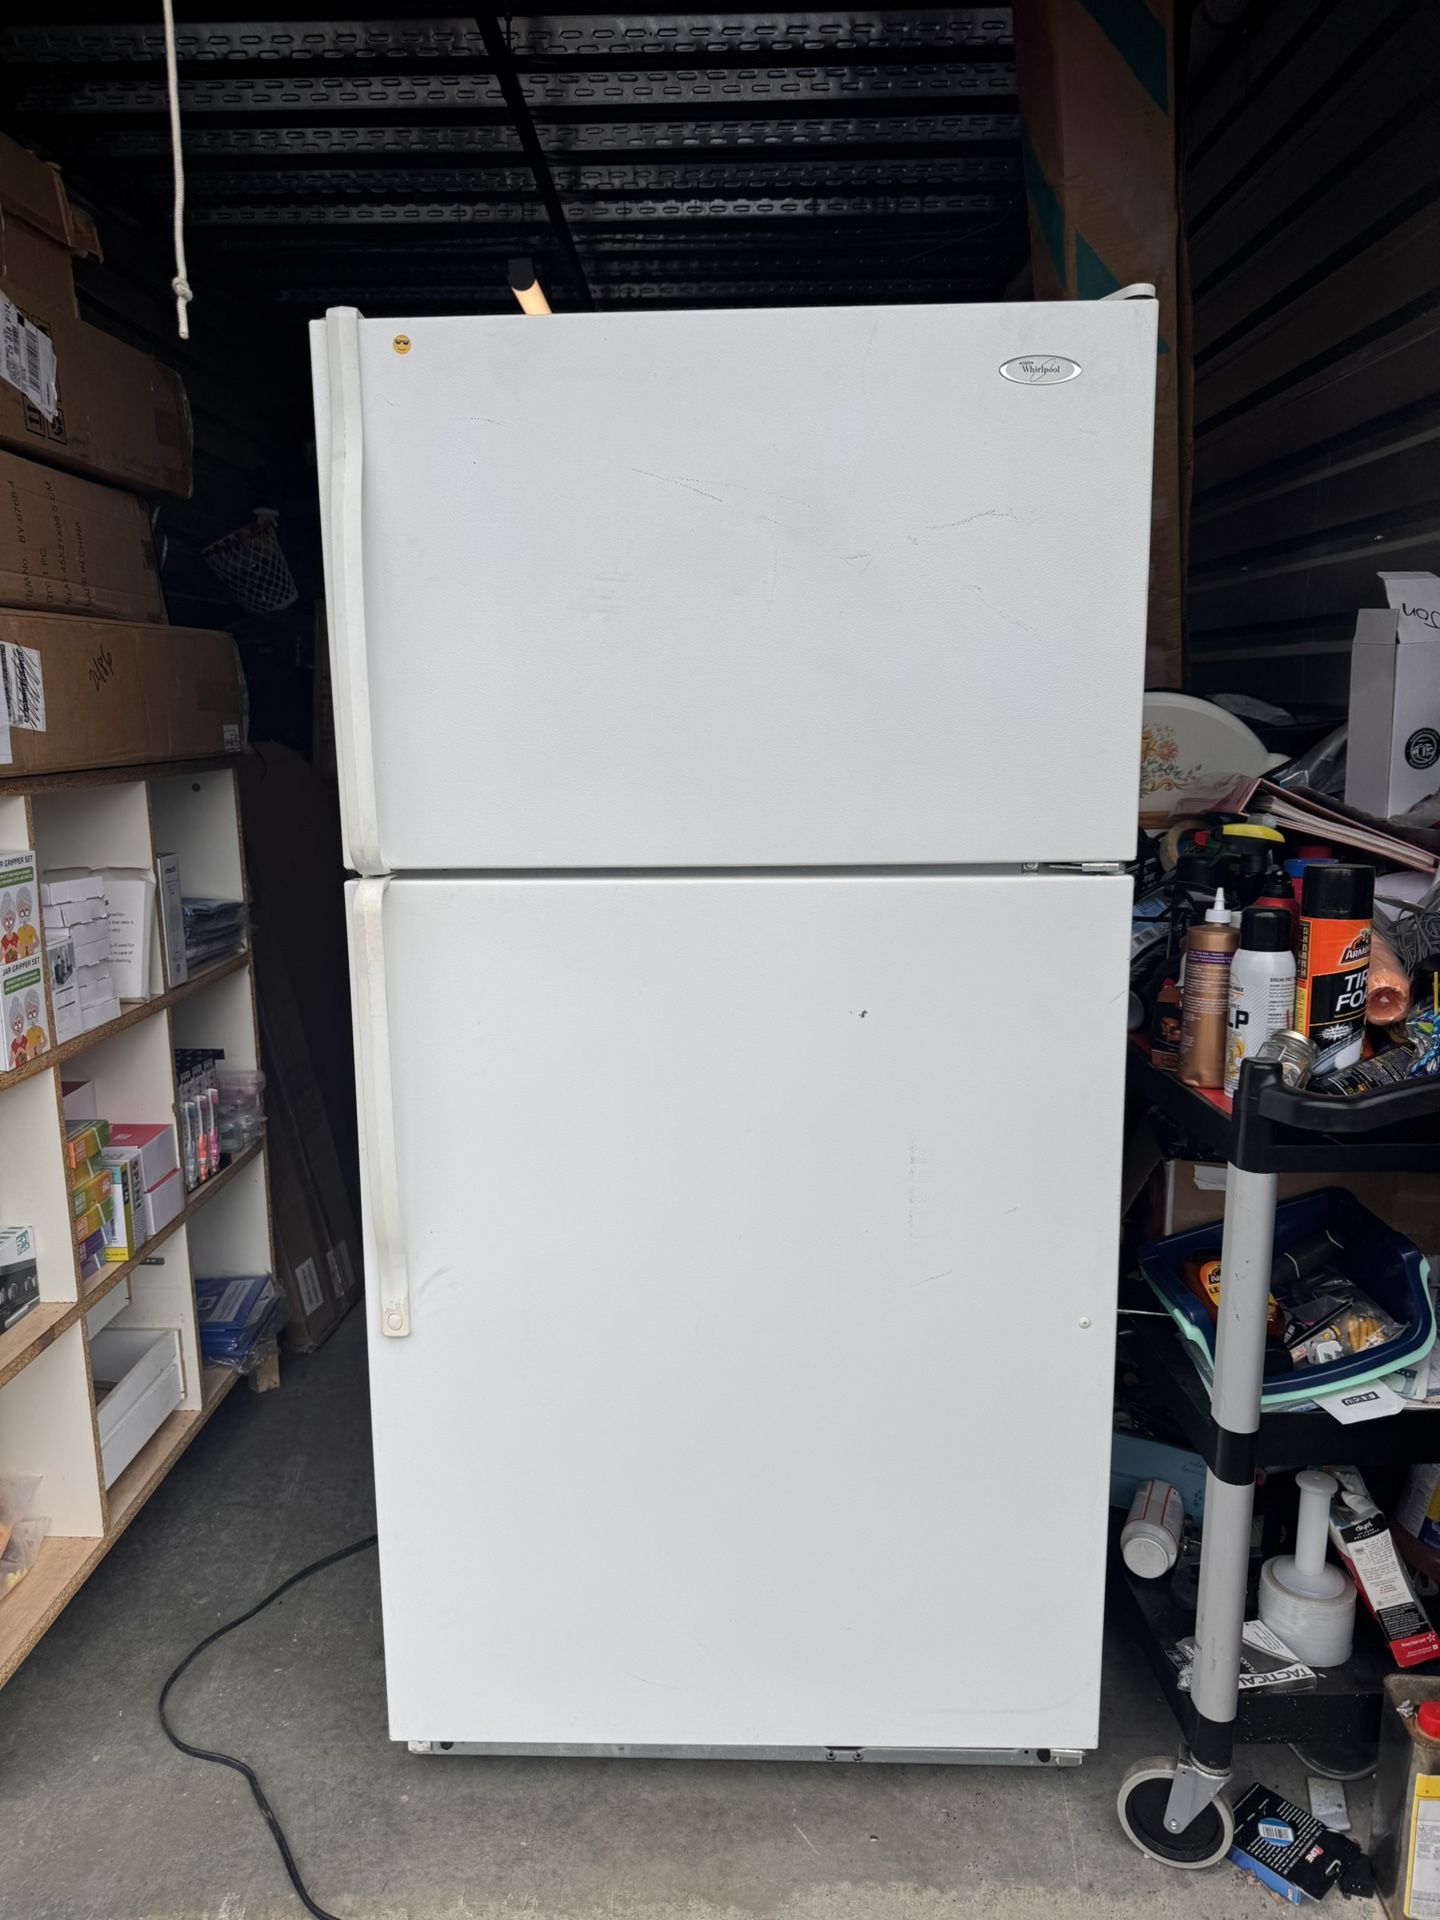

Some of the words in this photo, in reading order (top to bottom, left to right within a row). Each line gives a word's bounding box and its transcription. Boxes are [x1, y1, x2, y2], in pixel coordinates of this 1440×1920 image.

[1022, 365, 1060, 375] Whirlpool
[75, 521, 86, 558] CHINA
[24, 855, 33, 864] SET
[3, 967, 11, 976] JAR
[12, 961, 31, 973] GRIPPER
[31, 957, 40, 966] SET
[1345, 969, 1368, 991] TIR
[1335, 987, 1367, 1012] FO
[1344, 1393, 1377, 1405] BECU
